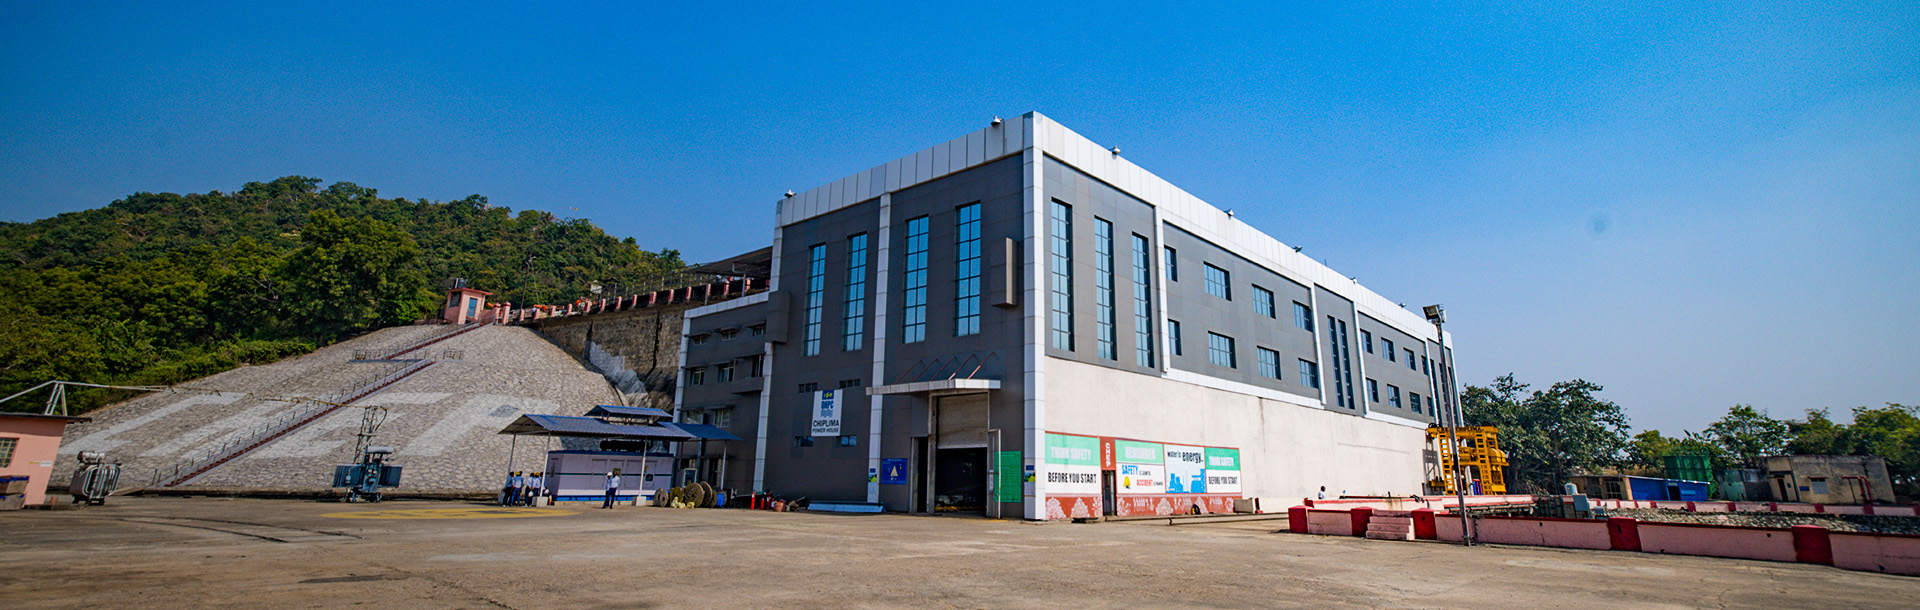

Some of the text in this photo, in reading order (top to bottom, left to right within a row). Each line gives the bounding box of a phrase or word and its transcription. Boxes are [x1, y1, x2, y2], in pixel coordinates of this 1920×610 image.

[1051, 446, 1091, 461] THINK SAFETY
[1125, 446, 1156, 460] REMEMBER
[1209, 456, 1234, 467] THINK SAFETY
[1121, 464, 1138, 475] SAFETY
[1047, 472, 1097, 484] BEFORE YOU START
[1208, 476, 1221, 485] BEFORE
[1228, 476, 1238, 485] START
